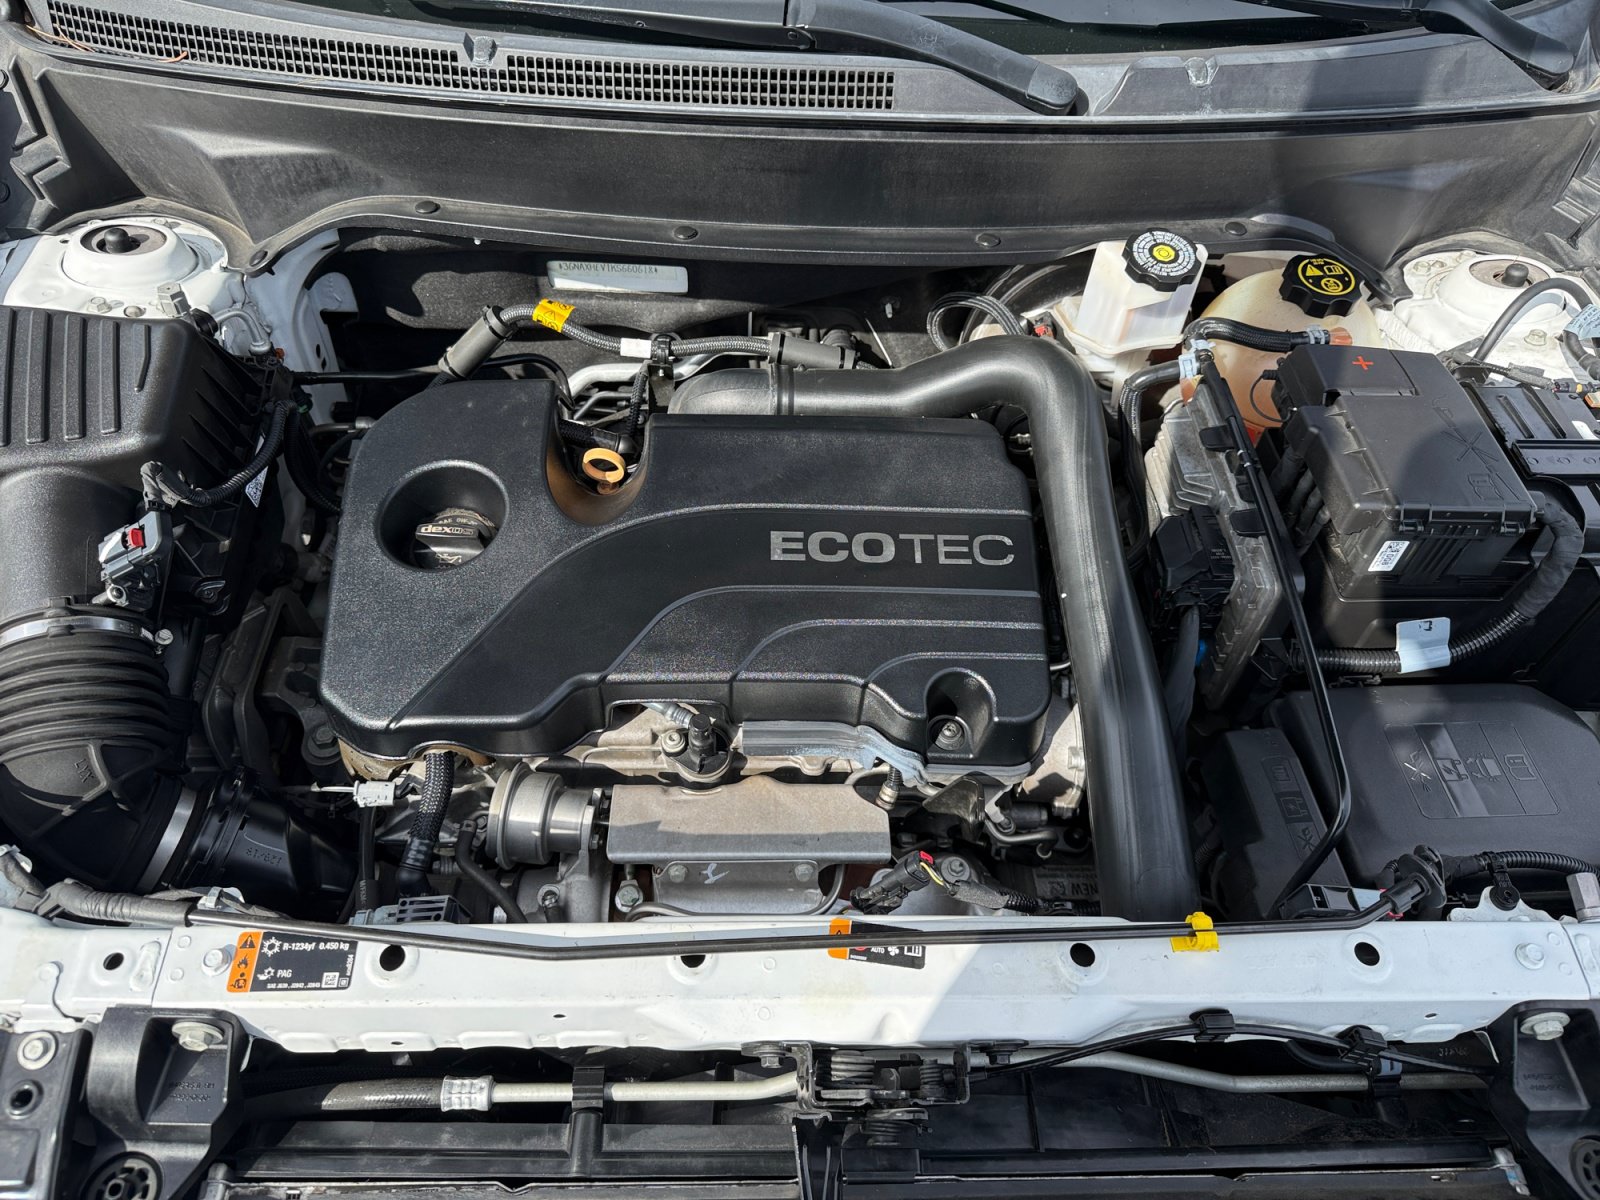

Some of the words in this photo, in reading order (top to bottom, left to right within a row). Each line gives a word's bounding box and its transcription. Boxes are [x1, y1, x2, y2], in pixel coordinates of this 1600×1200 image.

[420, 524, 474, 535] dexos
[770, 530, 1015, 566] ECOTEC
[282, 942, 316, 951] R-1234yf
[318, 941, 339, 950] 0.450
[339, 941, 350, 951] kg
[870, 946, 885, 954] AUTO
[276, 969, 292, 978] PAG
